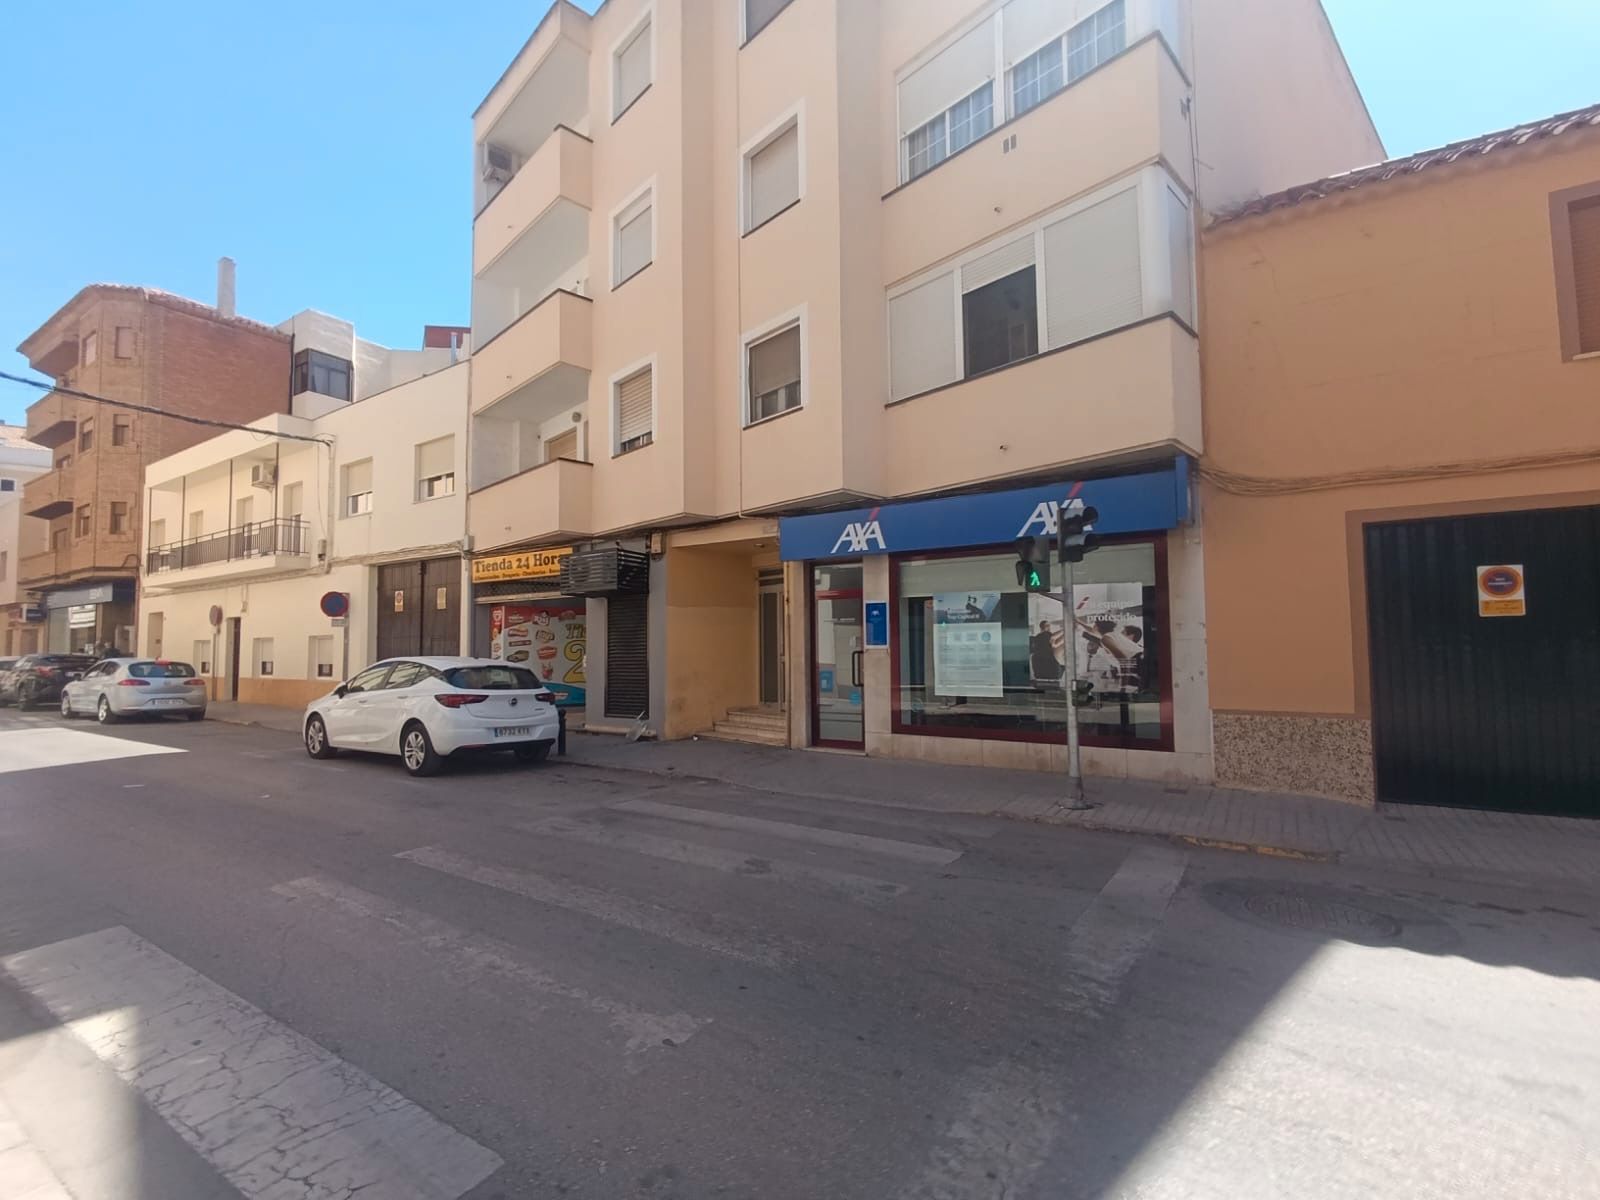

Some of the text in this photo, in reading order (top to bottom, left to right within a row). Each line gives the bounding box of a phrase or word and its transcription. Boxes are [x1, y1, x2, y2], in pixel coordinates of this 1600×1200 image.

[830, 520, 887, 554] AXA
[474, 553, 561, 573] Tienda 24 Hor
[563, 640, 586, 683] 2
